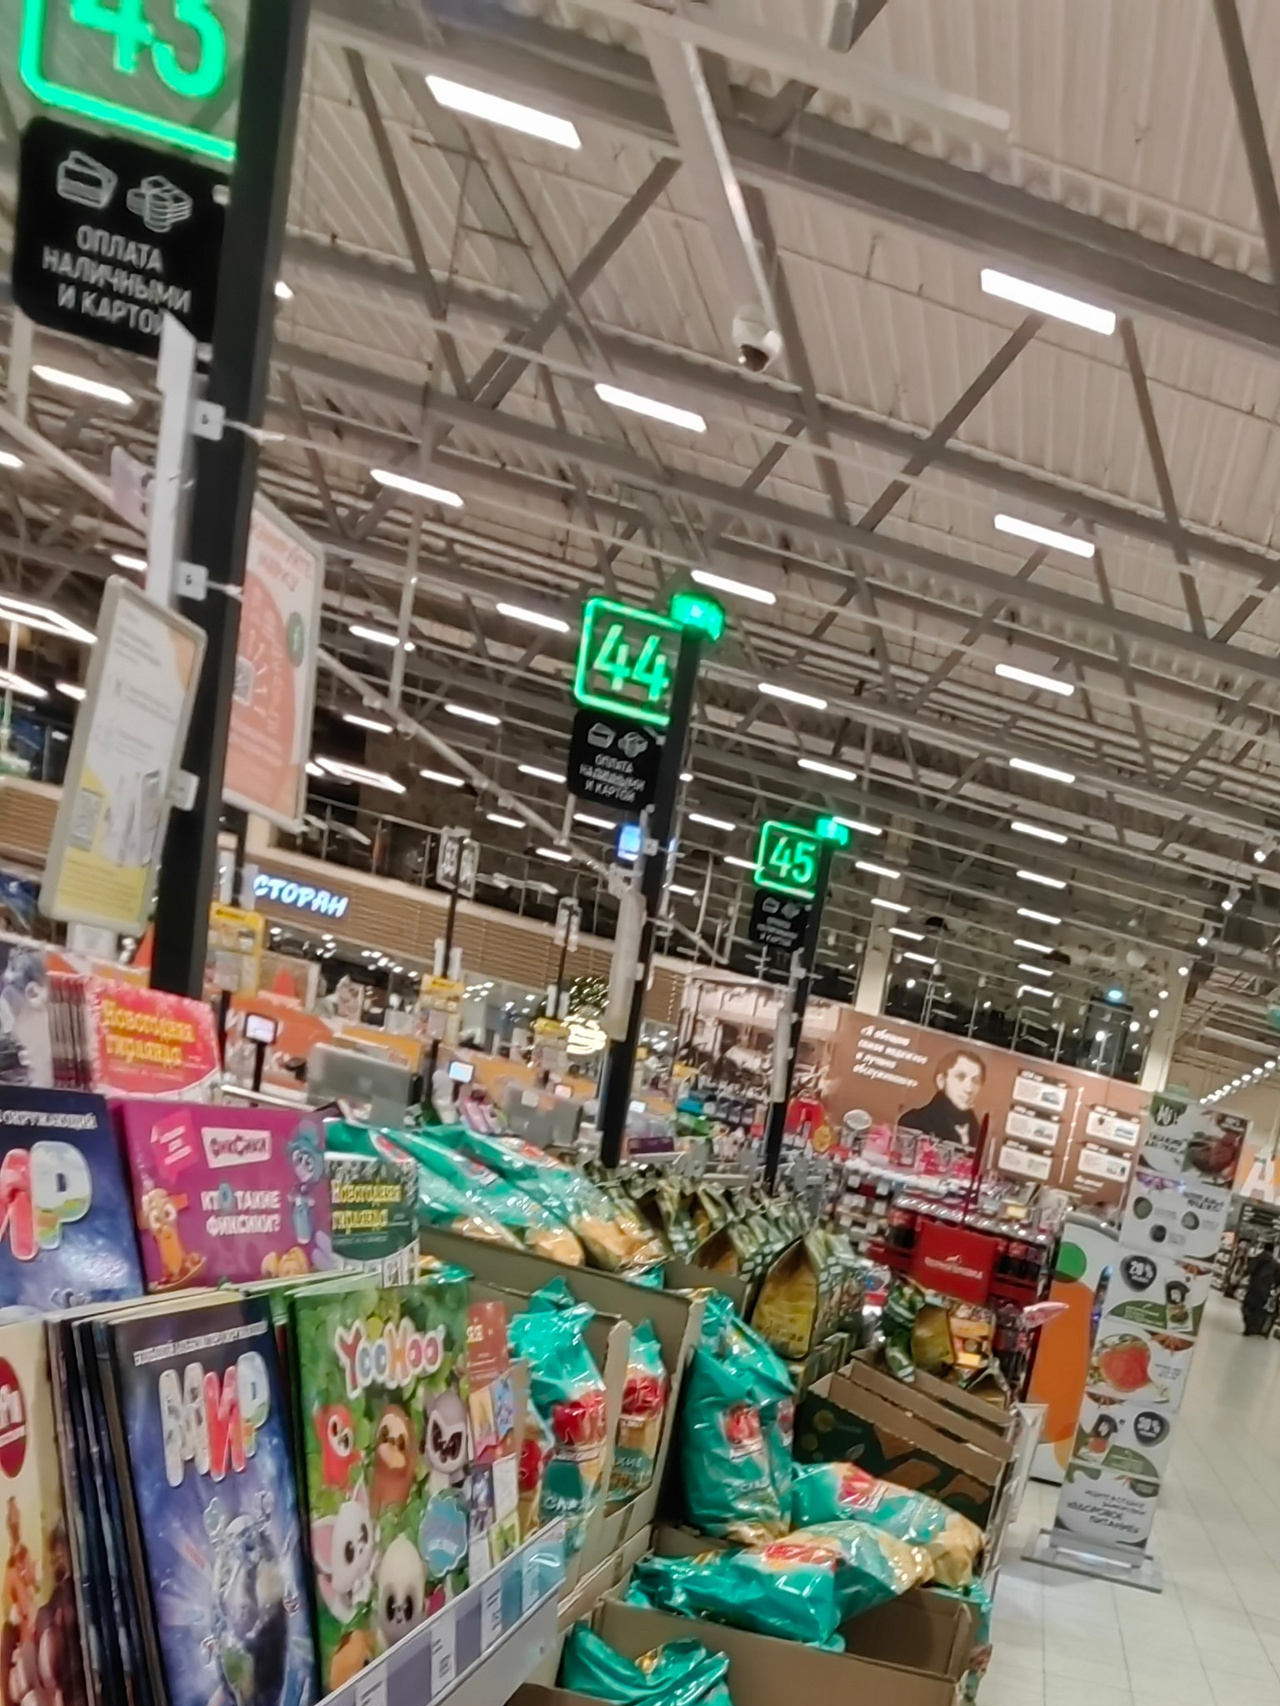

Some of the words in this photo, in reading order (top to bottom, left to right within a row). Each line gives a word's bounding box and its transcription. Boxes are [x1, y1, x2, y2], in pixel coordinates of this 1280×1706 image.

[76, 225, 163, 273] ОПЛАТА
[42, 245, 191, 313] НАЛИЧНЫМИ
[58, 283, 76, 309] И
[593, 624, 670, 701] 44
[769, 836, 816, 883] 45
[253, 874, 348, 918] СТОРАН
[335, 1319, 445, 1399] YooHoo
[159, 1351, 270, 1487] МИР
